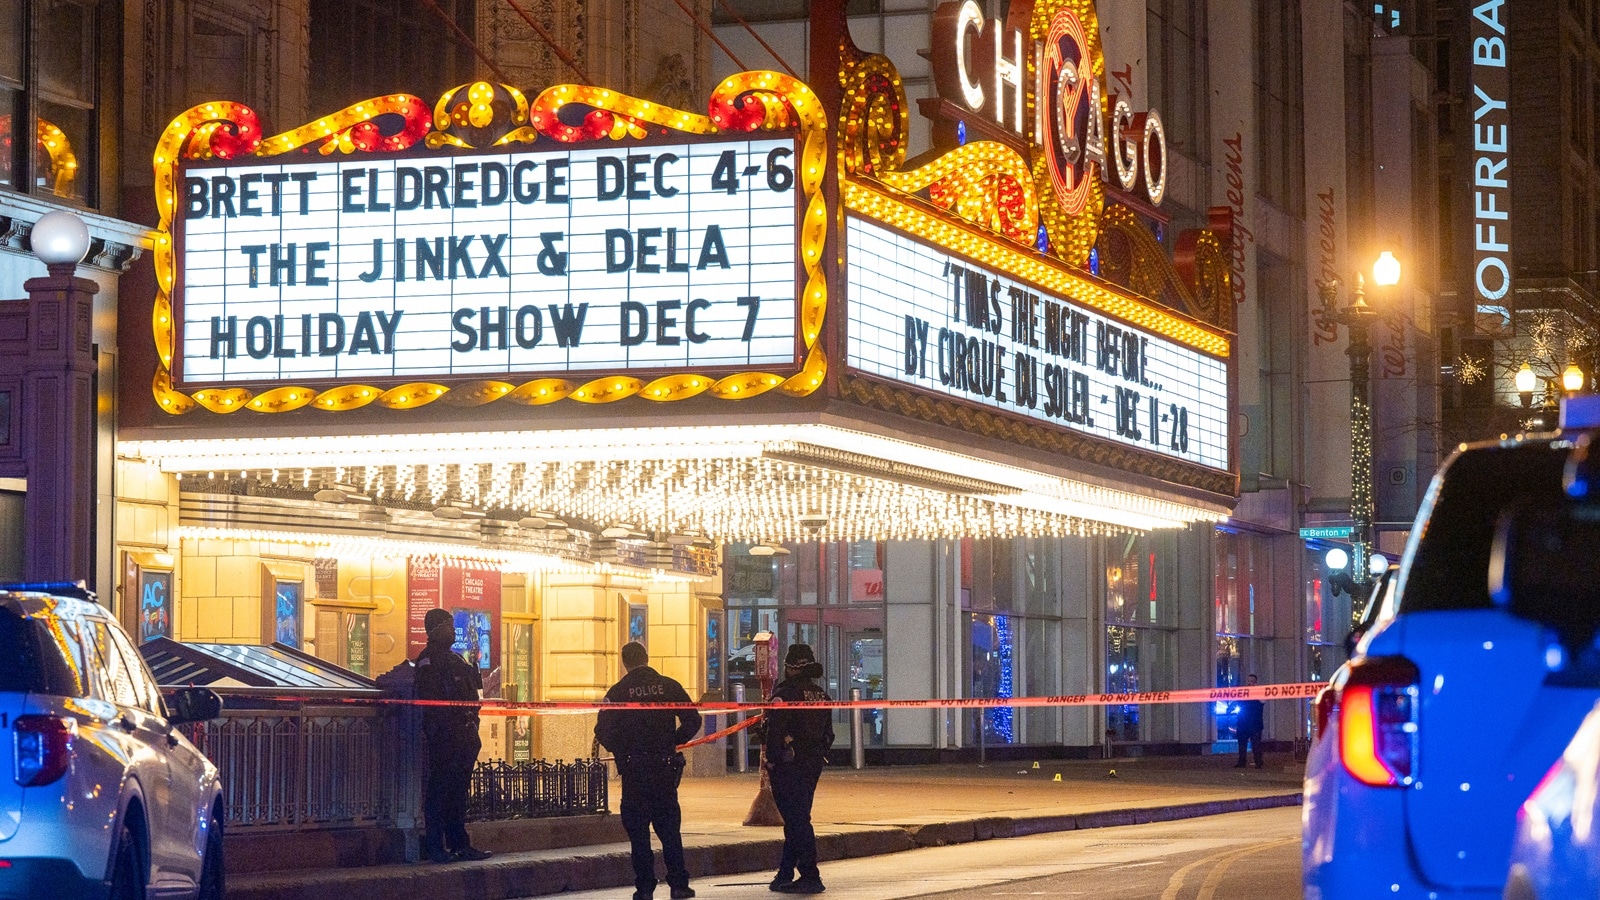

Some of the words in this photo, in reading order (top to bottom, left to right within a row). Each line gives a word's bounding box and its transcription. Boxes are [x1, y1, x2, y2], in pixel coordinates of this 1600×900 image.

[956, 0, 1167, 207] CHICAGO
[185, 171, 318, 219] BRETT
[342, 158, 570, 213] ELDREDGE
[597, 152, 681, 201] DEC
[711, 147, 794, 195] 4-6
[1474, 84, 1510, 326] JOFFREY
[241, 241, 330, 288] THE
[358, 233, 511, 283] JINKX
[537, 231, 567, 276] &
[605, 225, 731, 274] DELA
[1312, 187, 1339, 347] Wgreens
[210, 310, 404, 359] HOLIDAY
[451, 302, 589, 352] SHOW
[620, 298, 712, 346] DEC
[737, 296, 760, 341] 7
[1008, 285, 1040, 349] THE
[1044, 300, 1090, 366] NIGHT
[1096, 319, 1163, 391] BEFORE...
[904, 314, 929, 379] BY
[938, 327, 1007, 403] CIRQUE
[1015, 352, 1037, 410] DU
[1044, 362, 1094, 427] SOLEIL
[1115, 385, 1142, 441] DEC
[1310, 529, 1339, 537] Benton
[465, 578, 484, 587] CHICAGO
[465, 586, 484, 594] THEATRE
[629, 685, 664, 697] POLICE
[803, 690, 825, 702] POLICE
[1100, 694, 1114, 702] DO
[1116, 693, 1136, 702] NOT
[1138, 692, 1170, 701] ENTER
[1210, 689, 1250, 699] DANGER
[1265, 687, 1279, 697] DO
[1281, 686, 1301, 696] NOT
[1304, 684, 1330, 695] ENT
[1047, 695, 1086, 703] DANGER
